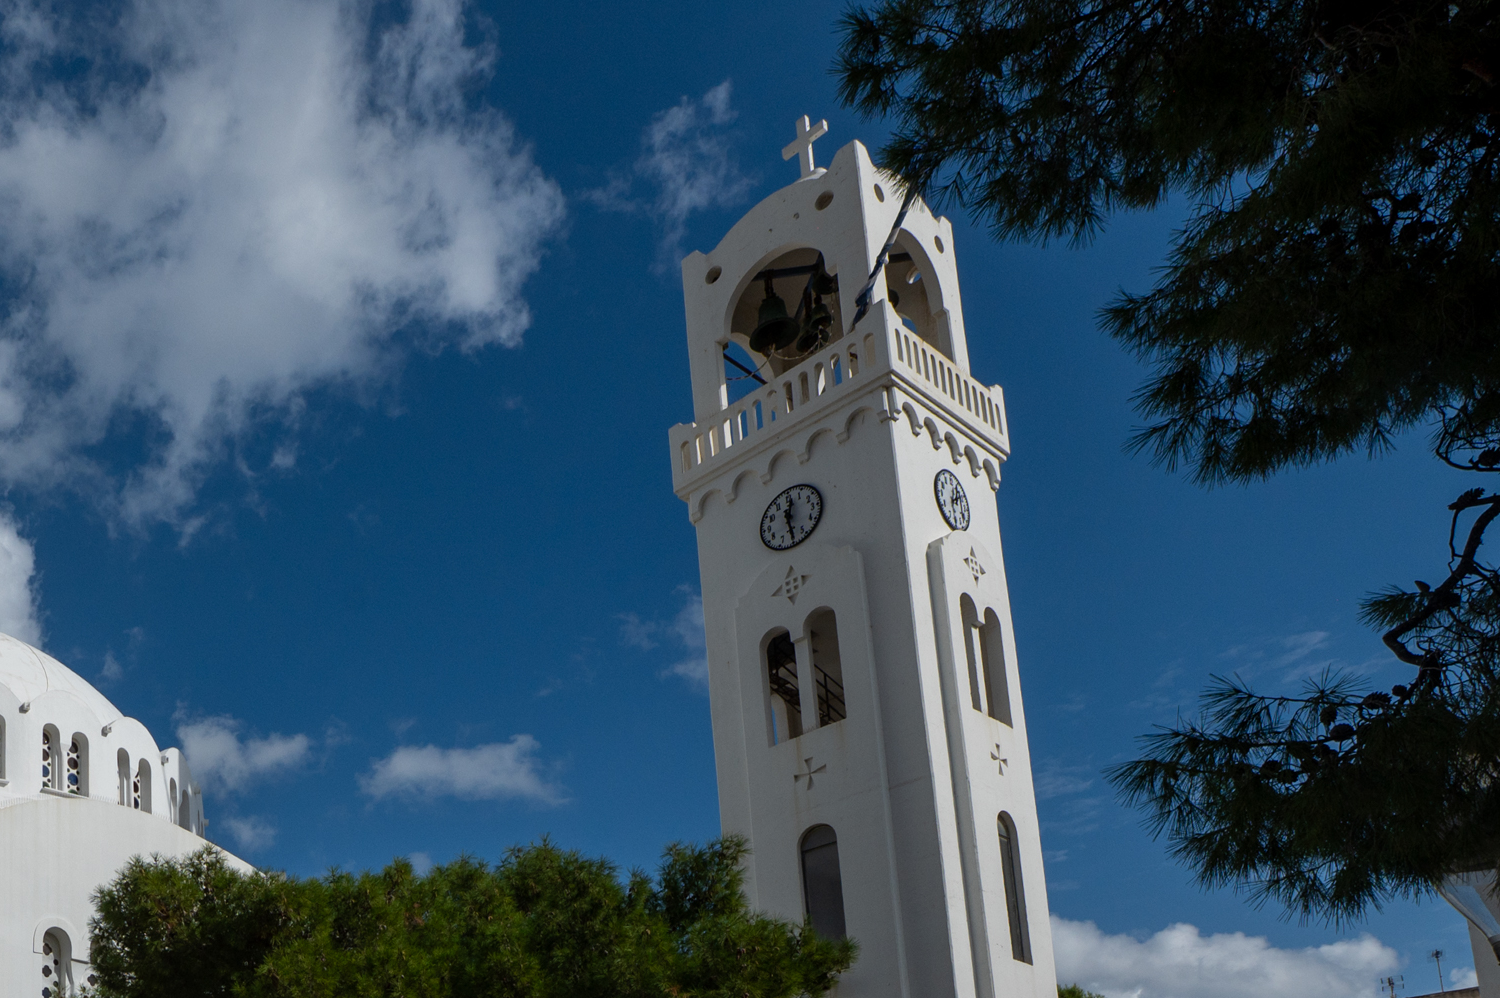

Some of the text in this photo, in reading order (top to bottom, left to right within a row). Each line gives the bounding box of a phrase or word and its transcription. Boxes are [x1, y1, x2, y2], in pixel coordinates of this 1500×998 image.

[797, 491, 801, 500] 1
[806, 495, 811, 504] 2
[811, 502, 815, 511] 3
[769, 513, 776, 523] 10
[808, 513, 812, 521] 4
[767, 524, 772, 534] 9
[800, 525, 805, 534] 5
[771, 532, 776, 541] 8
[780, 535, 785, 544] 7
